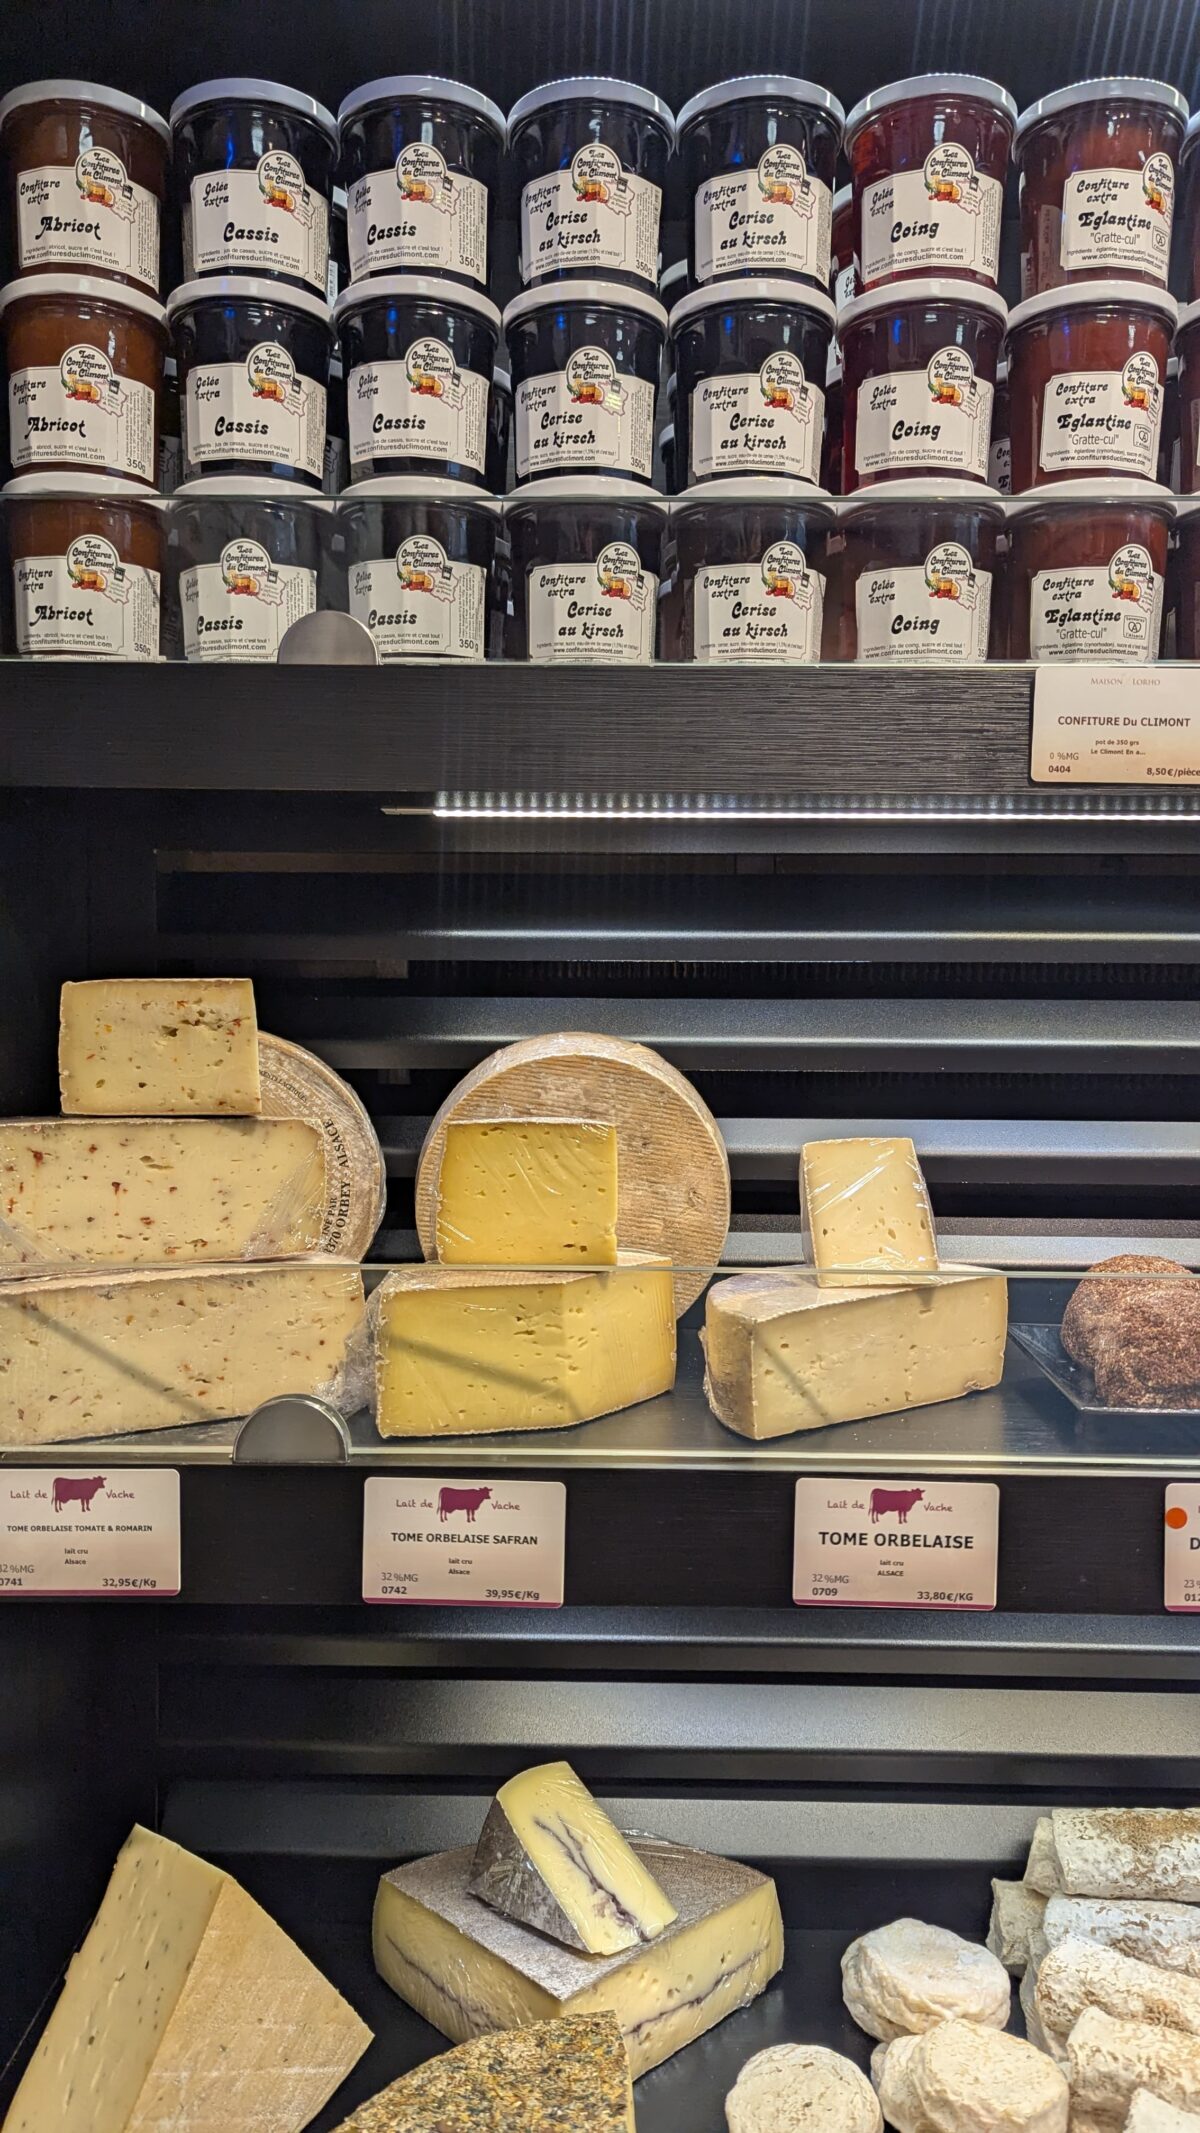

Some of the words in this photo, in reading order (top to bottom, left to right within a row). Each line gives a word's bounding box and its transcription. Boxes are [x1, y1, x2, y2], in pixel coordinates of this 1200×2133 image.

[20, 180, 60, 196] Confiture
[704, 183, 747, 204] Confiture
[1077, 178, 1129, 193] Confiture
[28, 192, 49, 205] extra
[204, 196, 229, 207] extra
[525, 184, 560, 207] Confiture
[1087, 192, 1118, 204] extra
[530, 200, 551, 214] extra
[710, 198, 736, 212] extra
[871, 200, 894, 217] extra
[35, 216, 101, 240] Abricot
[546, 211, 588, 231] Cerise
[729, 211, 774, 230] Cerise
[1078, 210, 1152, 231] Eglantine
[223, 222, 279, 243] Cassis
[367, 221, 416, 245] Cassis
[891, 221, 939, 243] Coing
[539, 239, 553, 252] au
[557, 229, 600, 248] kirsch
[720, 237, 737, 250] au
[742, 231, 787, 248] kirsch
[79, 350, 95, 360] Les
[66, 357, 107, 370] Confitures
[79, 368, 109, 379] Climont
[13, 379, 46, 396] Confiture
[358, 386, 379, 399] extra
[521, 385, 556, 404] Confiture
[703, 386, 749, 401] Confiture
[1056, 381, 1108, 396] Confiture
[18, 393, 36, 405] extra
[526, 400, 547, 412] extra
[710, 399, 737, 411] extra
[871, 398, 897, 411] extra
[1065, 395, 1096, 407] extra
[24, 417, 86, 440] Abricot
[215, 416, 269, 436] Cassis
[373, 413, 426, 433] Cassis
[541, 411, 583, 430] Cerise
[730, 413, 775, 431] Cerise
[1057, 413, 1131, 432] Eglantine
[892, 420, 941, 441] Coing
[533, 437, 548, 449] au
[553, 430, 596, 448] kirsch
[721, 438, 738, 449] au
[743, 434, 786, 451] kirsch
[540, 574, 586, 587] Confiture
[703, 575, 750, 589] Confiture
[1043, 577, 1094, 591] Confiture
[548, 588, 575, 599] extra
[712, 588, 739, 600] extra
[870, 592, 895, 605] extra
[1053, 590, 1081, 602] extra
[29, 605, 94, 627] Abricot
[568, 601, 612, 619] Cerise
[732, 601, 777, 619] Cerise
[1045, 608, 1121, 627] Eglantine
[197, 616, 243, 635] Cassis
[368, 609, 417, 629] Cassis
[891, 614, 940, 635] Coing
[559, 626, 576, 636] au
[582, 622, 624, 639] kirsch
[723, 627, 740, 637] au
[746, 623, 788, 639] kirsch
[1058, 716, 1120, 726] CONFITURE
[1124, 718, 1137, 726] Du
[1141, 718, 1190, 727] CLIMONT
[323, 1119, 349, 1168] ALSACE
[328, 1198, 337, 1215] PAR
[336, 1181, 350, 1228] ORBEY
[10, 1490, 30, 1498] Lait
[35, 1490, 48, 1498] de
[106, 1490, 135, 1498] Vache
[396, 1500, 416, 1508] Lait
[421, 1500, 433, 1508] de
[491, 1502, 520, 1510] Vache
[827, 1500, 848, 1509] Lait
[852, 1501, 864, 1509] de
[924, 1502, 953, 1512] Vache
[391, 1532, 423, 1541] TOME
[426, 1534, 490, 1543] ORBELAISE
[493, 1535, 537, 1544] SAFRAN
[819, 1532, 868, 1545] TOME
[874, 1534, 974, 1549] ORBELAISE
[102, 1578, 156, 1588] 32,95€/Kg
[382, 1586, 407, 1594] 0742
[485, 1589, 540, 1600] 39,95€/Kg
[812, 1588, 838, 1596] 0709
[917, 1592, 973, 1601] 33,80€/KG
